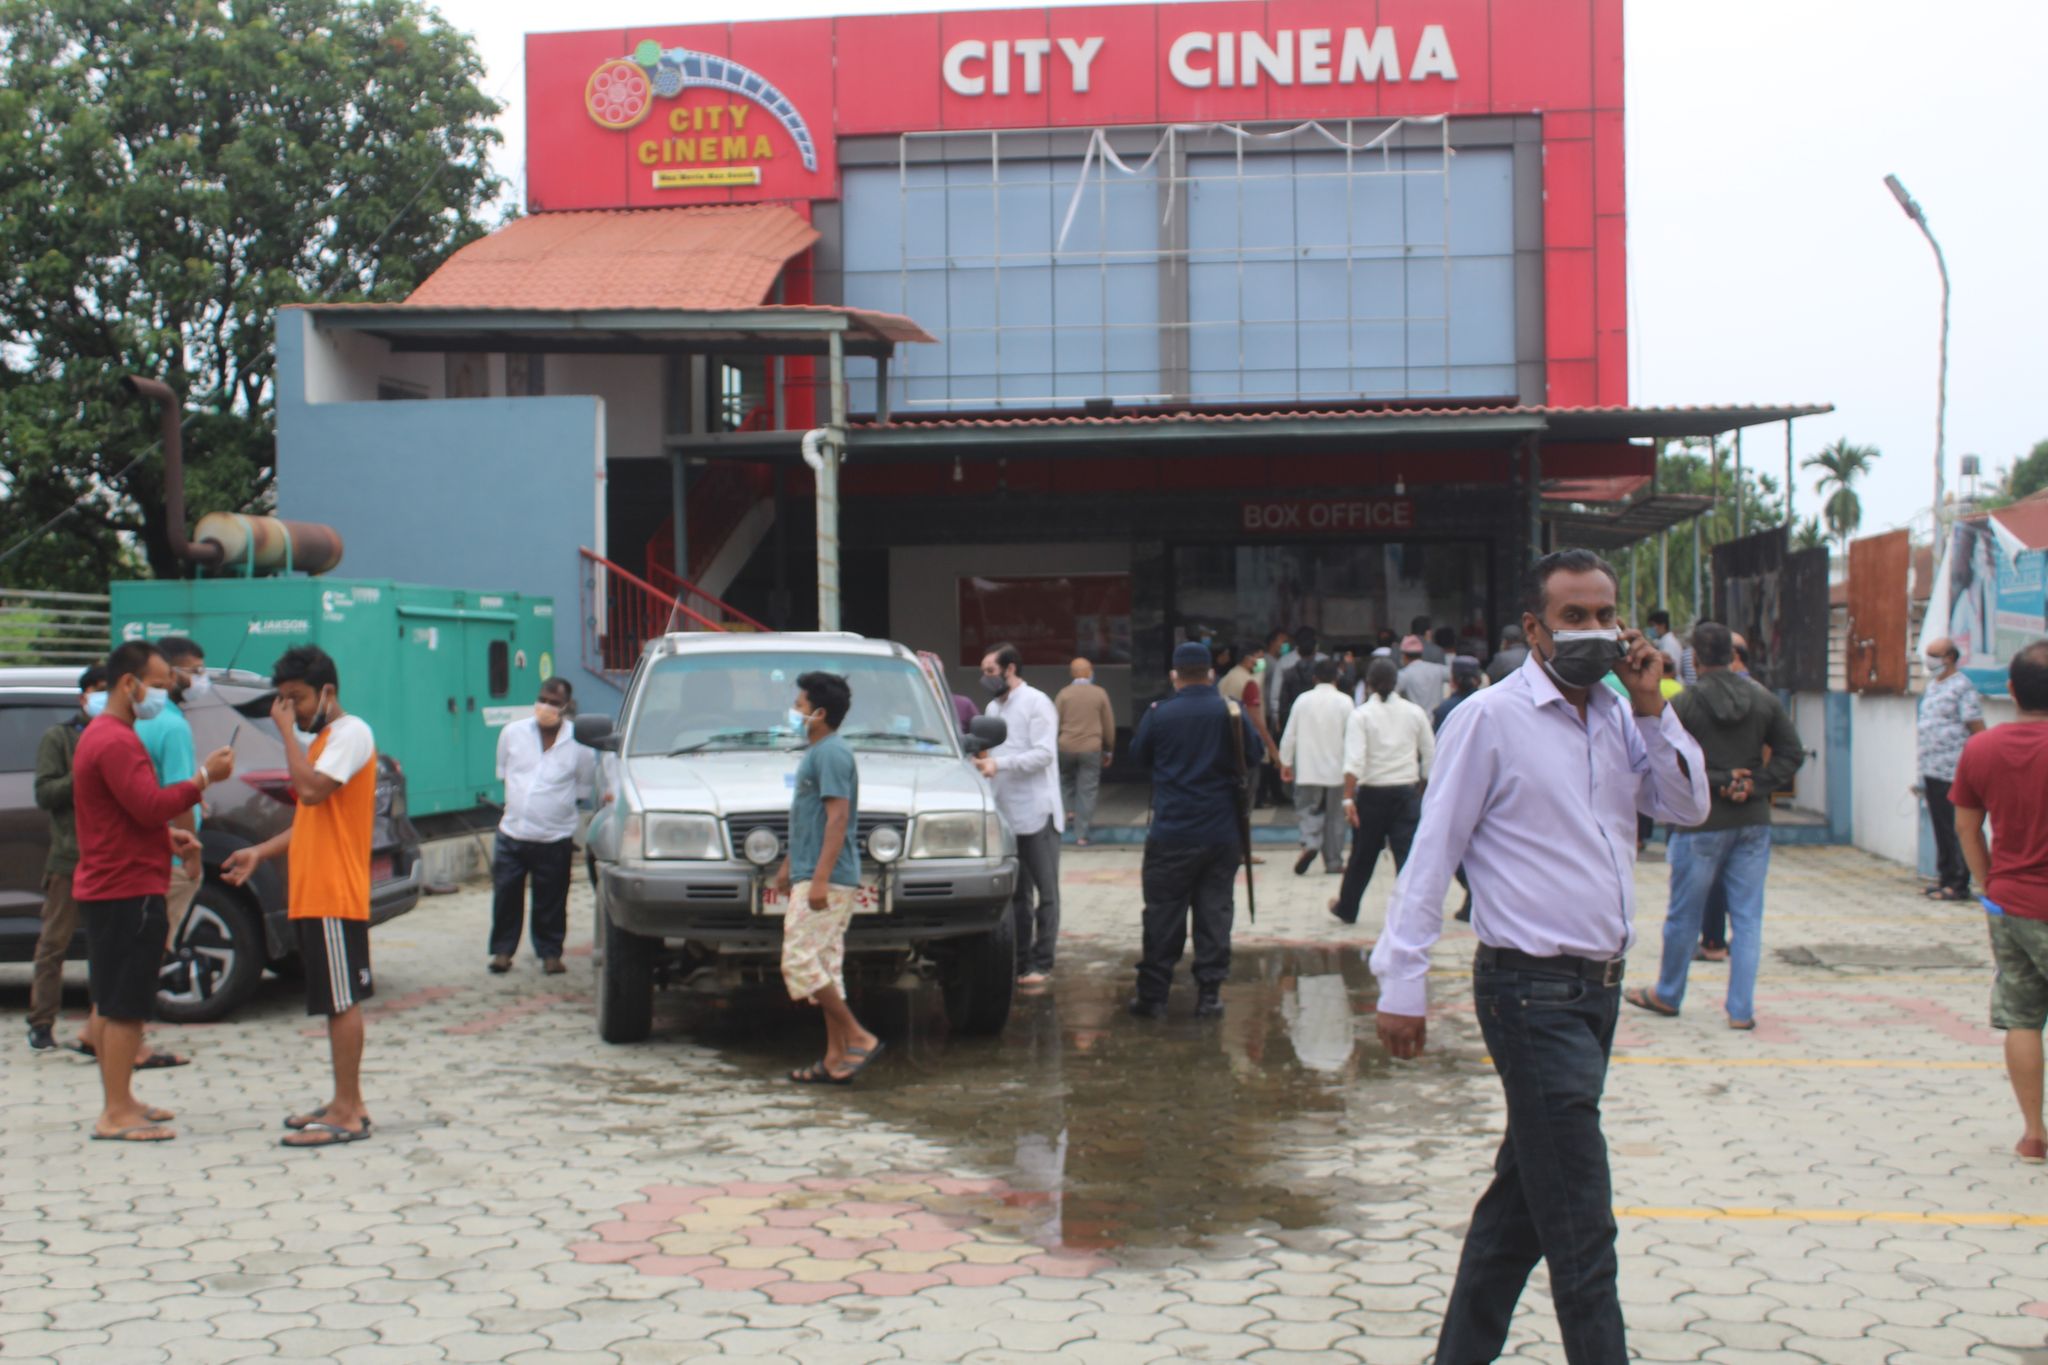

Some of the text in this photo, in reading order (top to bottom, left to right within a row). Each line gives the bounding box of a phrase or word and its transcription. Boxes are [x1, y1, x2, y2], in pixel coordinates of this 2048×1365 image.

[943, 25, 1459, 97] CITY CINEMA
[669, 104, 749, 133] CITY
[638, 134, 773, 166] CINEMA
[1243, 501, 1410, 528] BOX OFFICE
